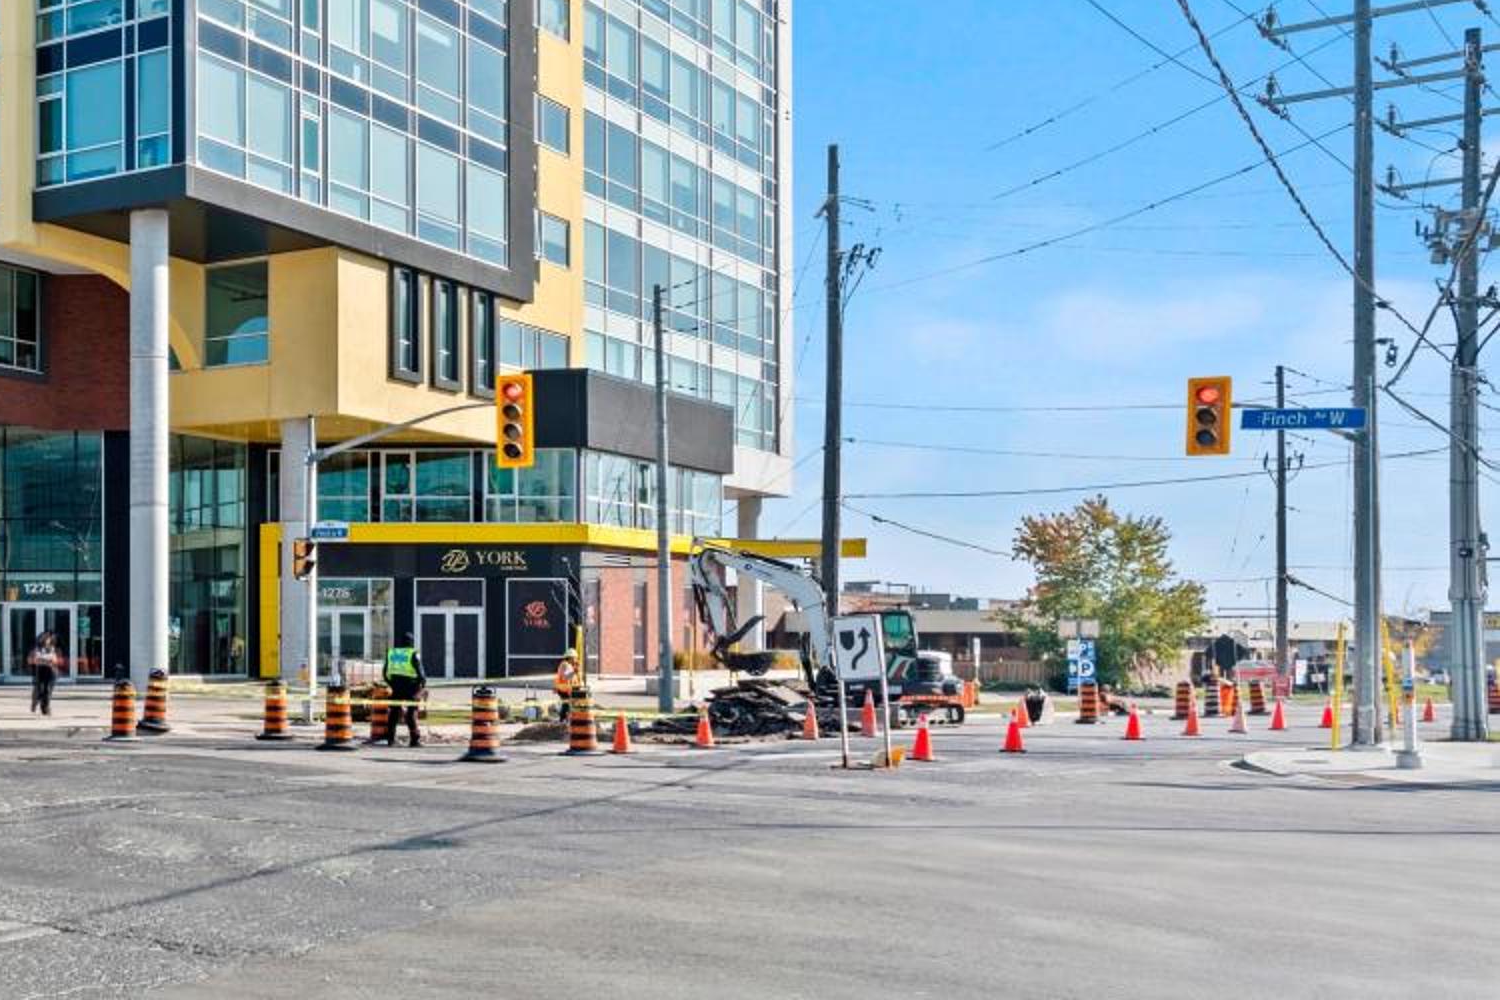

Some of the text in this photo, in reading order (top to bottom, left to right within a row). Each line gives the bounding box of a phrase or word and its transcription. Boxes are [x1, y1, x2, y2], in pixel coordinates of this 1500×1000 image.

[1261, 411, 1307, 425] Finch
[1329, 410, 1345, 425] W
[475, 551, 527, 565] YORK
[23, 583, 55, 595] 1275
